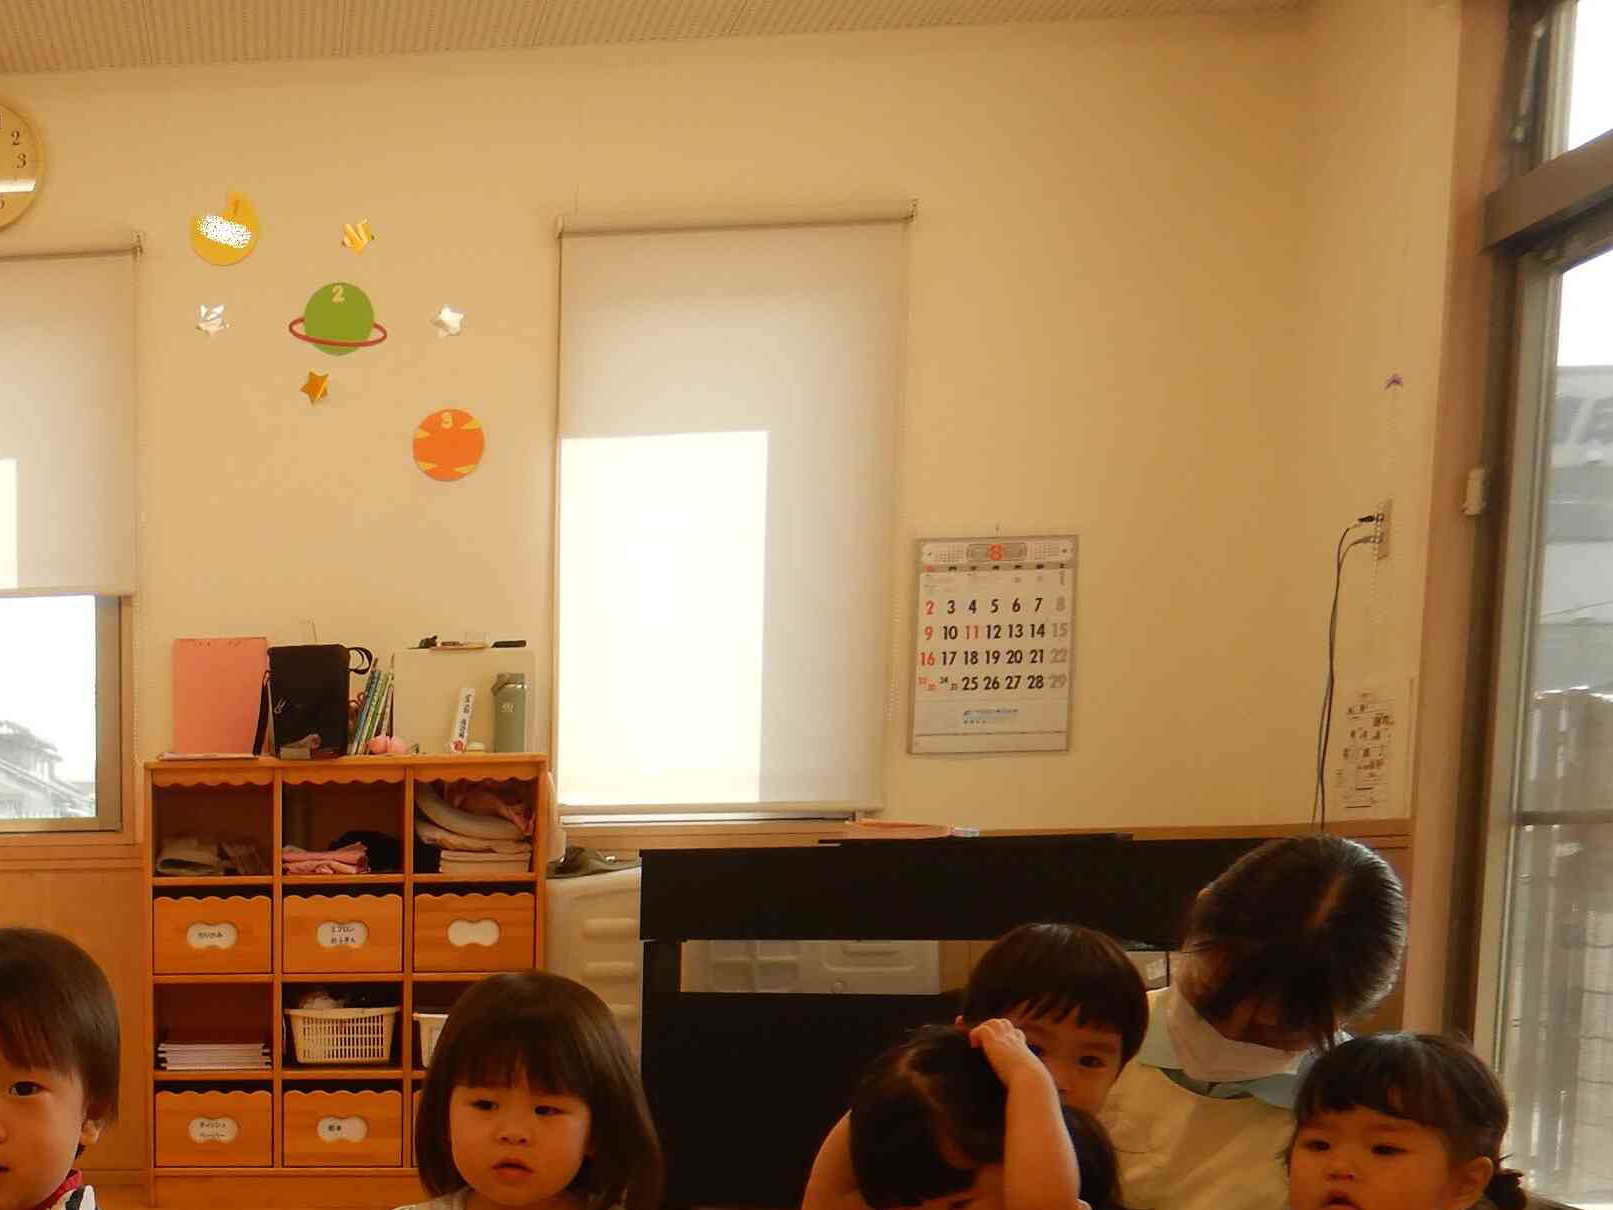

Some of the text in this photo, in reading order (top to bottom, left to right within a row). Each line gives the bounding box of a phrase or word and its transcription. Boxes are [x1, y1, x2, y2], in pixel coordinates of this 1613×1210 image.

[11, 130, 20, 146] 2
[17, 153, 27, 169] 3
[332, 285, 346, 304] 2
[442, 411, 454, 429] 3
[989, 544, 1005, 561] 8
[926, 597, 1065, 615] 2 3 4 5 6 7 8
[924, 622, 1068, 640] 9 10 11 12 13 14 15
[920, 649, 1067, 666] 16 17 18 19 20 21 22
[962, 676, 978, 690] 25
[983, 676, 1000, 690] 26
[1005, 676, 1022, 690] 27
[1027, 675, 1044, 689] 28
[1049, 674, 1067, 689] 29
